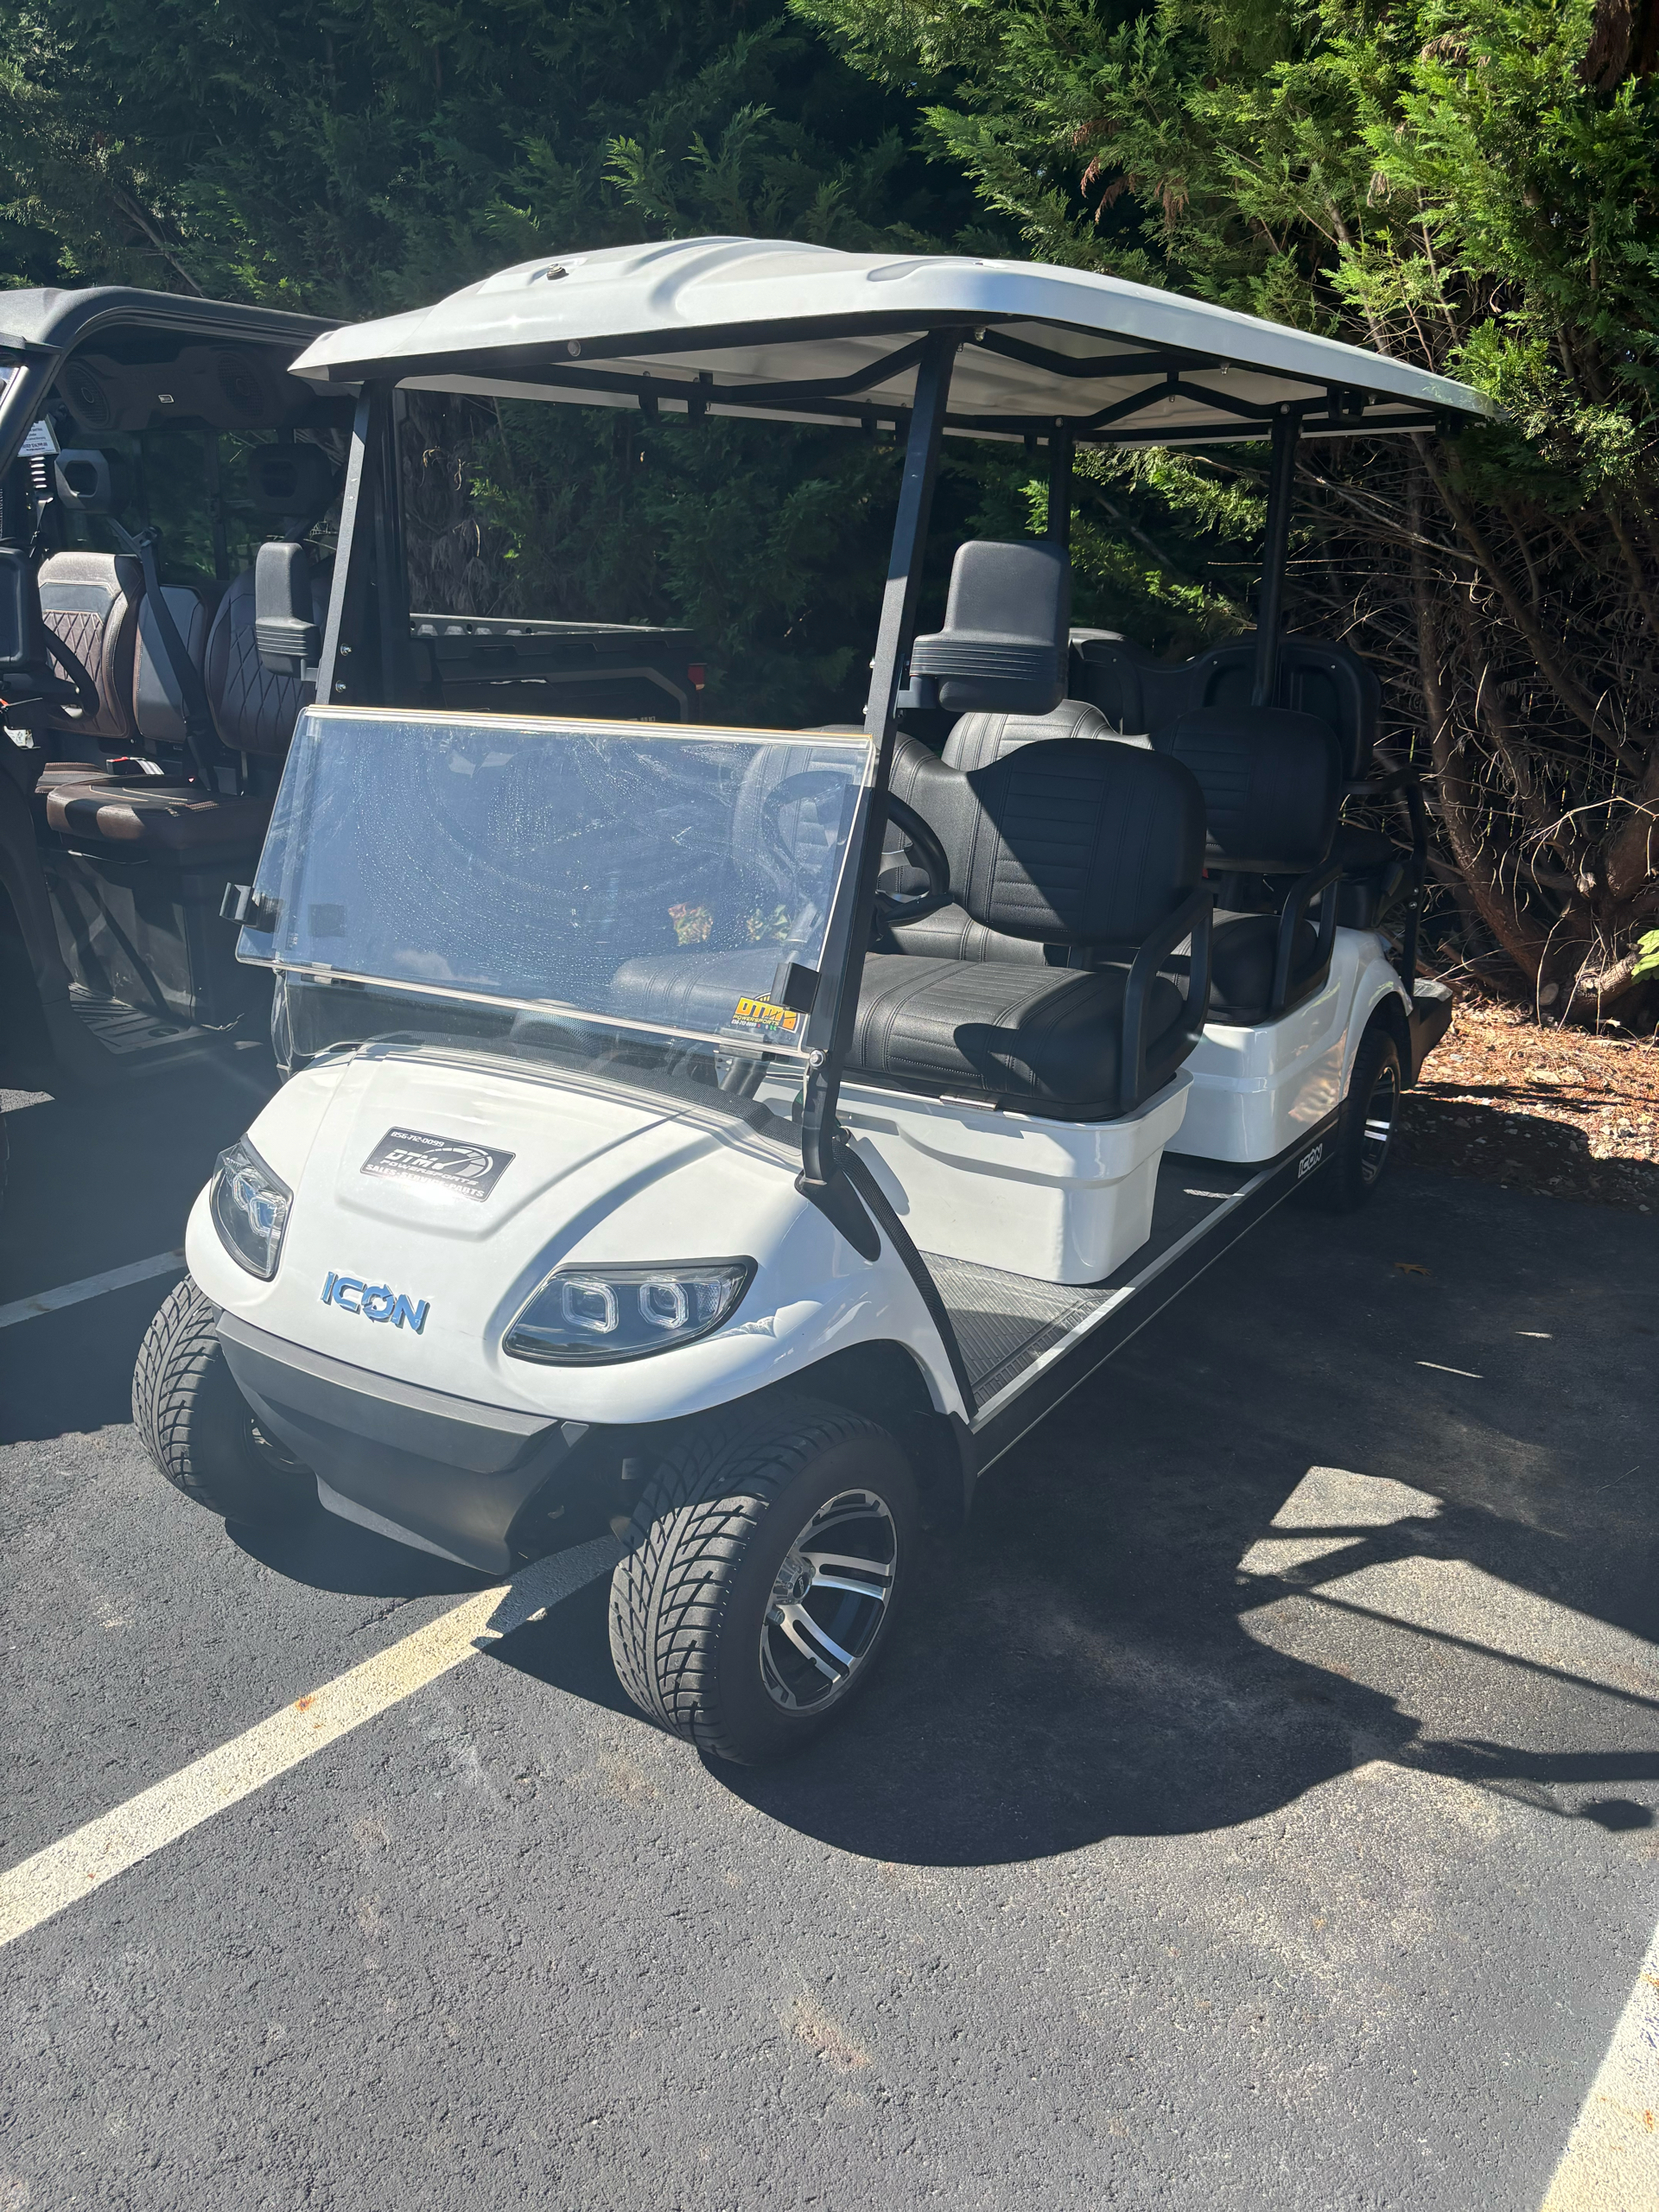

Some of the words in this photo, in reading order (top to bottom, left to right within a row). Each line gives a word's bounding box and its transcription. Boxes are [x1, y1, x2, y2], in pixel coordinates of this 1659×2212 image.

[734, 996, 784, 1021] DTM
[385, 1148, 439, 1168] DTM
[1298, 1143, 1323, 1179] ICON
[379, 1159, 479, 1185] POWERSPORTS
[321, 1271, 430, 1335] ICON
